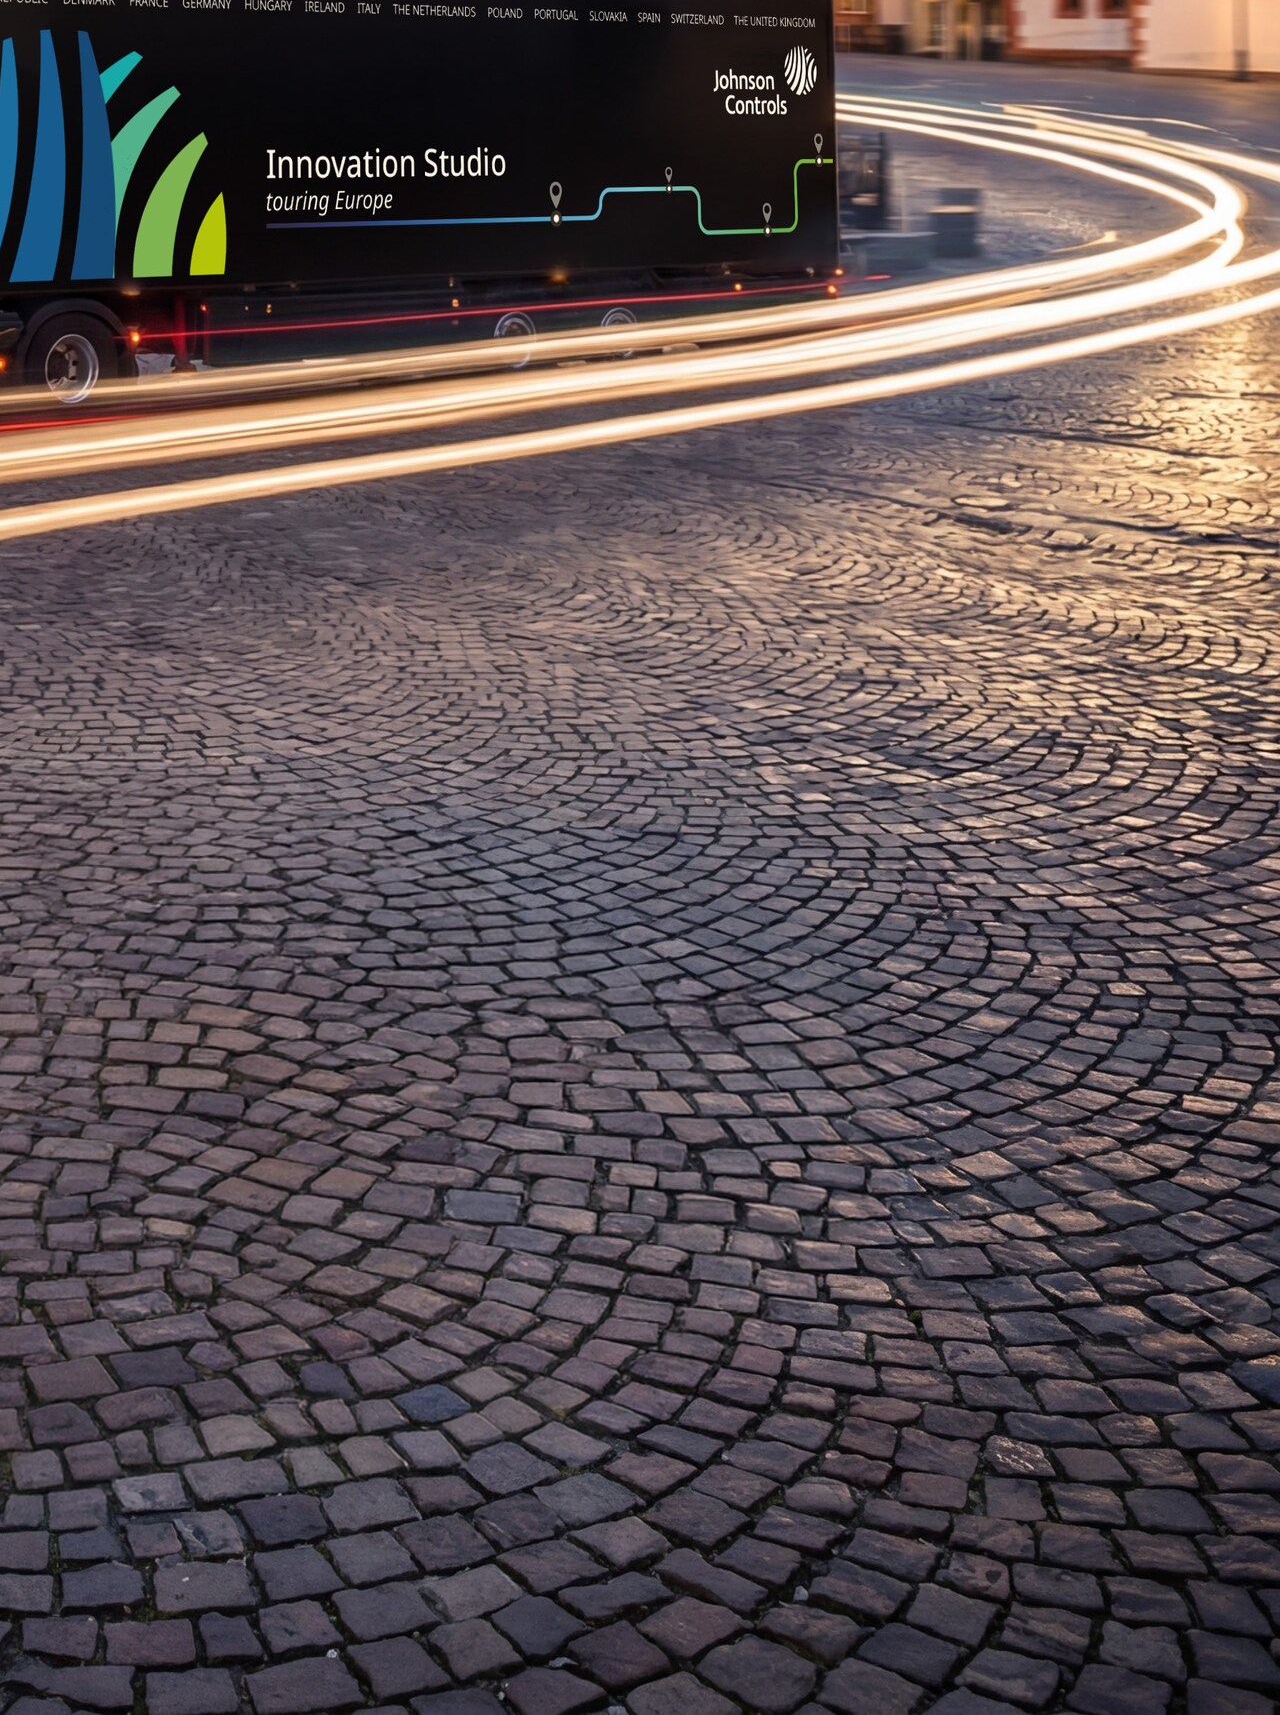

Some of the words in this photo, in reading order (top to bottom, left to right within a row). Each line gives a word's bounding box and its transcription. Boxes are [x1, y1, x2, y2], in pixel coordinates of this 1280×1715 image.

[244, 0, 293, 12] HUNGARY
[304, 0, 345, 14] IRELAND
[357, 2, 381, 15] ITALY
[392, 3, 411, 16] THE
[413, 4, 477, 18] NETHERLANDS
[487, 6, 523, 19] POLAND
[534, 8, 579, 21] PORTUGAL
[589, 10, 628, 22] SLOVAKIA
[637, 11, 661, 23] SPAIN
[670, 13, 725, 26] SWITZERLAND
[733, 15, 749, 27] THE
[750, 16, 778, 28] UNITED
[779, 17, 816, 28] KINGDOM
[713, 68, 775, 92] Johnson
[725, 94, 788, 116] Controls
[266, 147, 416, 179] Innovation
[424, 146, 507, 178] Studio
[266, 190, 330, 217] touring
[334, 190, 393, 216] Europe
